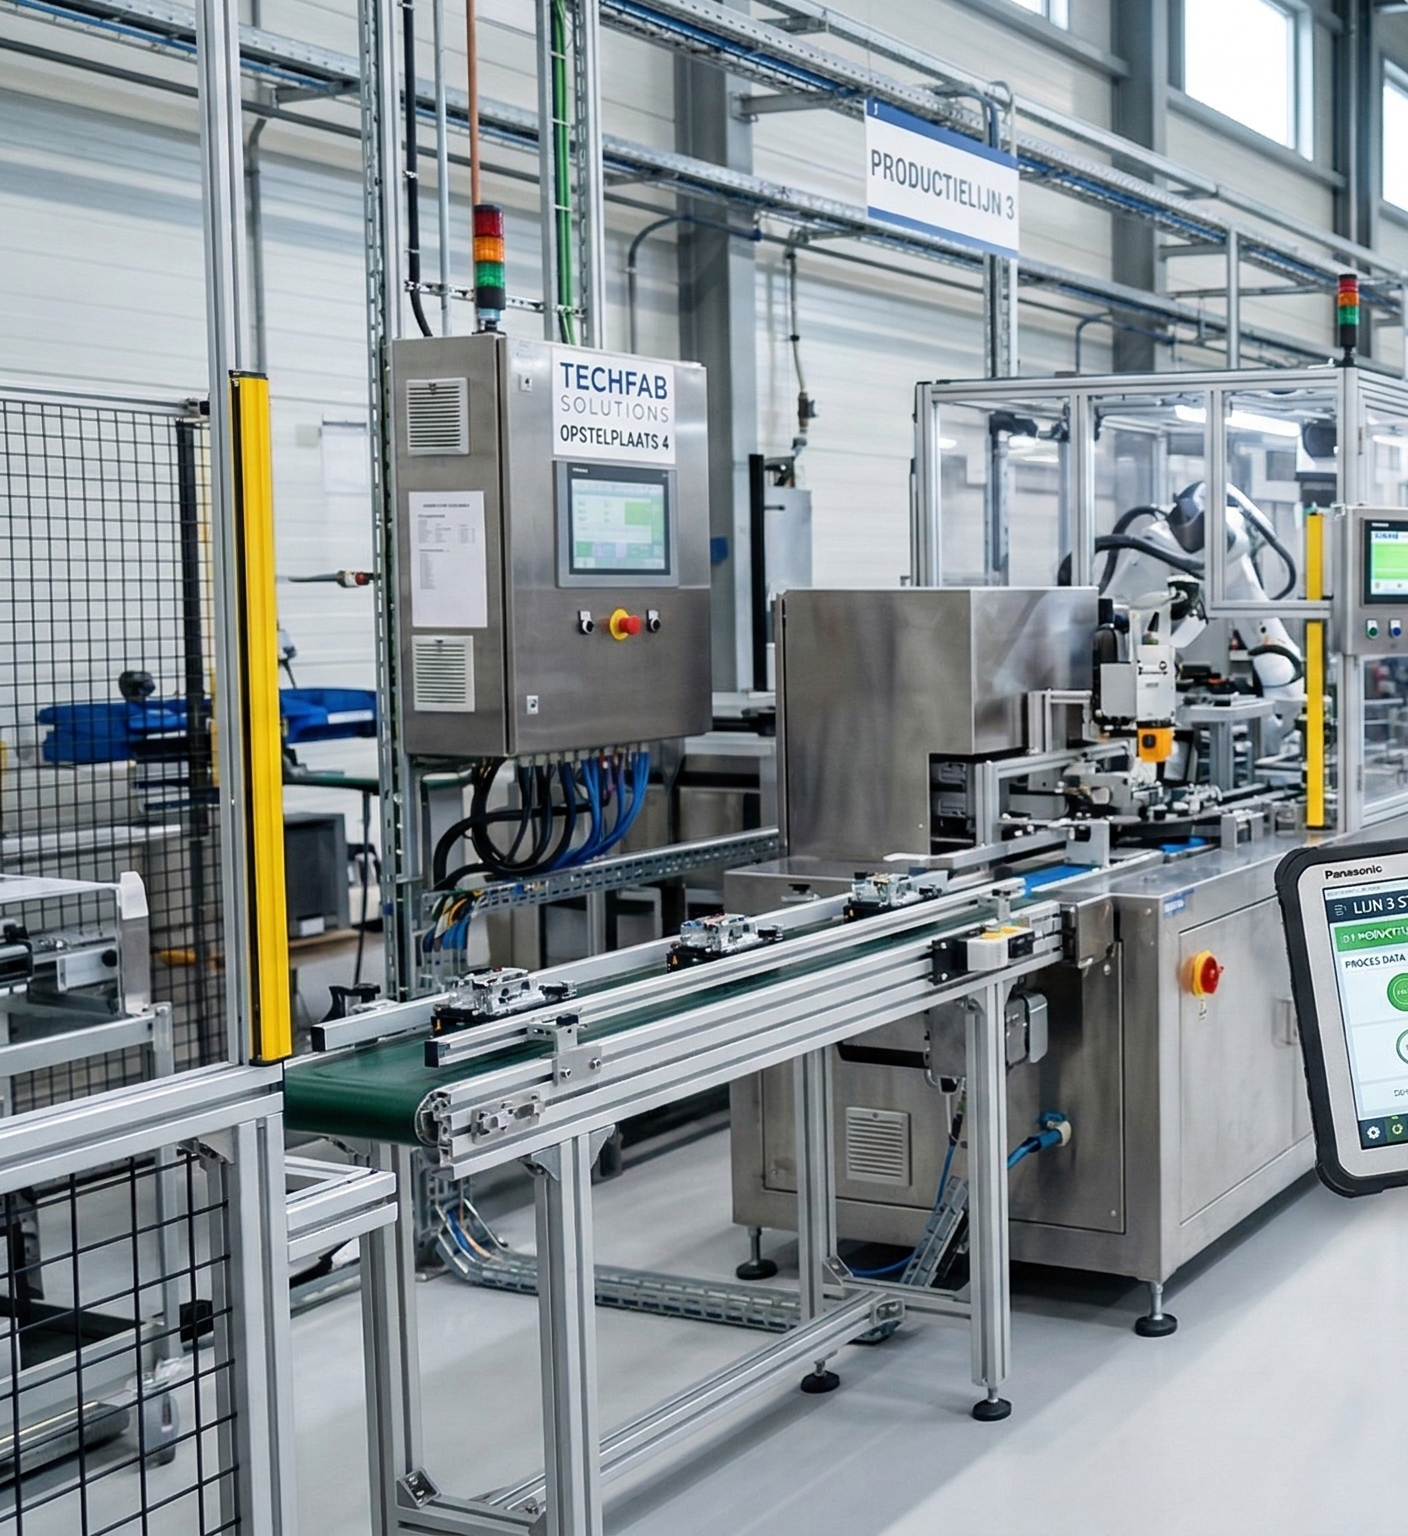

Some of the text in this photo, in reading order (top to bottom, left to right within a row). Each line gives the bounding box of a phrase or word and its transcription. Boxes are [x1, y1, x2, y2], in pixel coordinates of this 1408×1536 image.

[871, 149, 1015, 220] PRODUCTIELIJN 3
[559, 361, 668, 400] TECHFAB
[560, 394, 669, 423] SOLUTIONS
[560, 424, 669, 450] OPSTELPLAATS 4
[1324, 864, 1383, 880] Panasonic
[1386, 897, 1395, 910] 3
[1345, 954, 1406, 969] PROCES DATA
